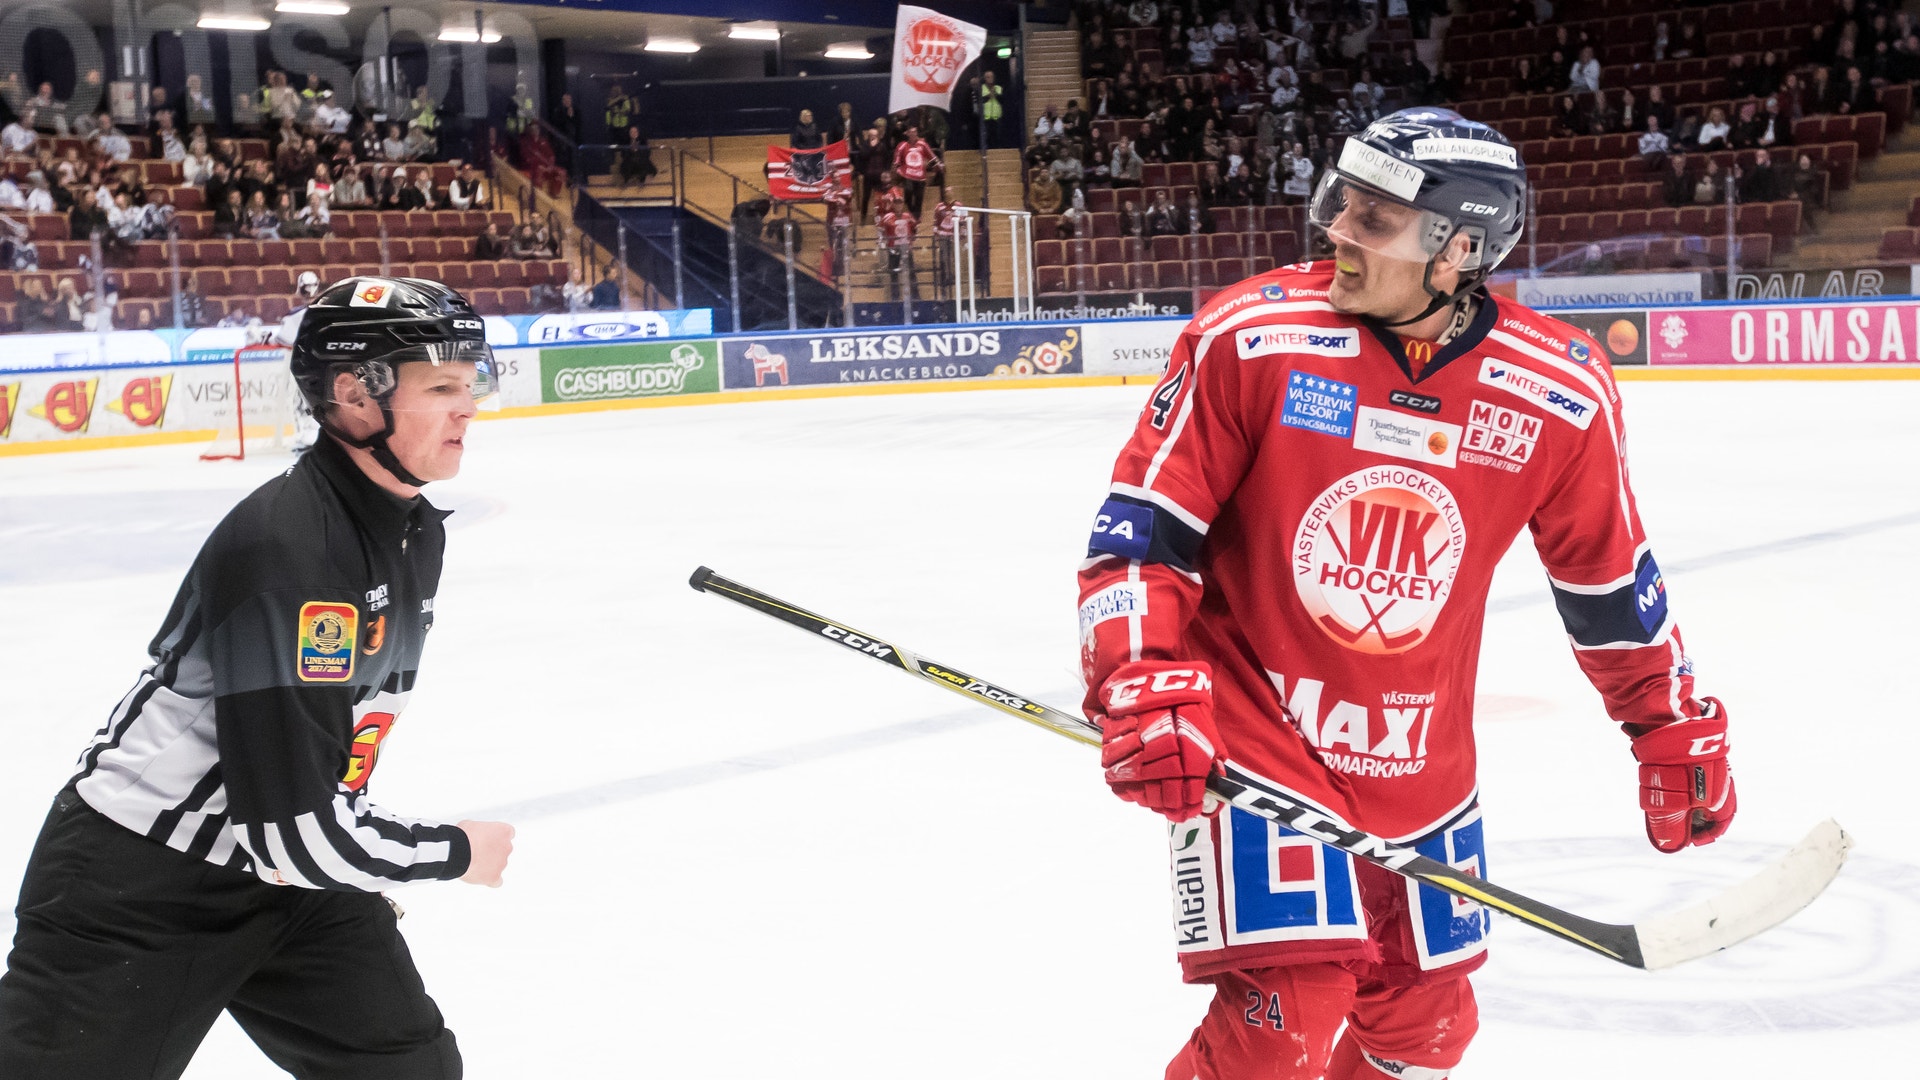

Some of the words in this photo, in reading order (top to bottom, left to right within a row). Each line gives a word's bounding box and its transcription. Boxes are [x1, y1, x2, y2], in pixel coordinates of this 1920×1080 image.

[1358, 147, 1417, 182] HOLMEN
[1459, 202, 1499, 216] CCM
[1199, 293, 1262, 328] Västerviks
[326, 342, 367, 350] CCM
[810, 331, 1000, 363] LEKSANDS
[1265, 333, 1351, 349] INTERSPORT
[1503, 319, 1566, 352] Västerviks
[1731, 308, 1920, 362] ORMSA
[559, 365, 684, 396] CASHBUDDY
[840, 363, 971, 383] KNÄCKEBRÖD
[1589, 357, 1618, 404] Kommun
[1289, 386, 1353, 412] VÄSTERVIK
[1294, 403, 1341, 422] RESORT
[1391, 392, 1440, 410] CCM
[1506, 372, 1590, 418] INTERSPORT
[1282, 415, 1349, 436] LYSINGSBADET
[1375, 430, 1412, 447] Sparbank
[1460, 450, 1523, 474] RESURSPARTNER
[1294, 480, 1358, 576] VÄSTERVIKS
[1349, 499, 1440, 577] VIK
[1319, 562, 1444, 602] HOCKEY
[821, 624, 891, 659] CCM
[304, 656, 347, 665] LINESMAN
[926, 666, 967, 685] SUPER
[962, 678, 1028, 709] TACKS
[1106, 669, 1212, 709] CCM
[1264, 668, 1435, 760] MAXI
[1232, 783, 1422, 871] CCM
[1178, 854, 1210, 946] klean
[1245, 990, 1285, 1031] 24
